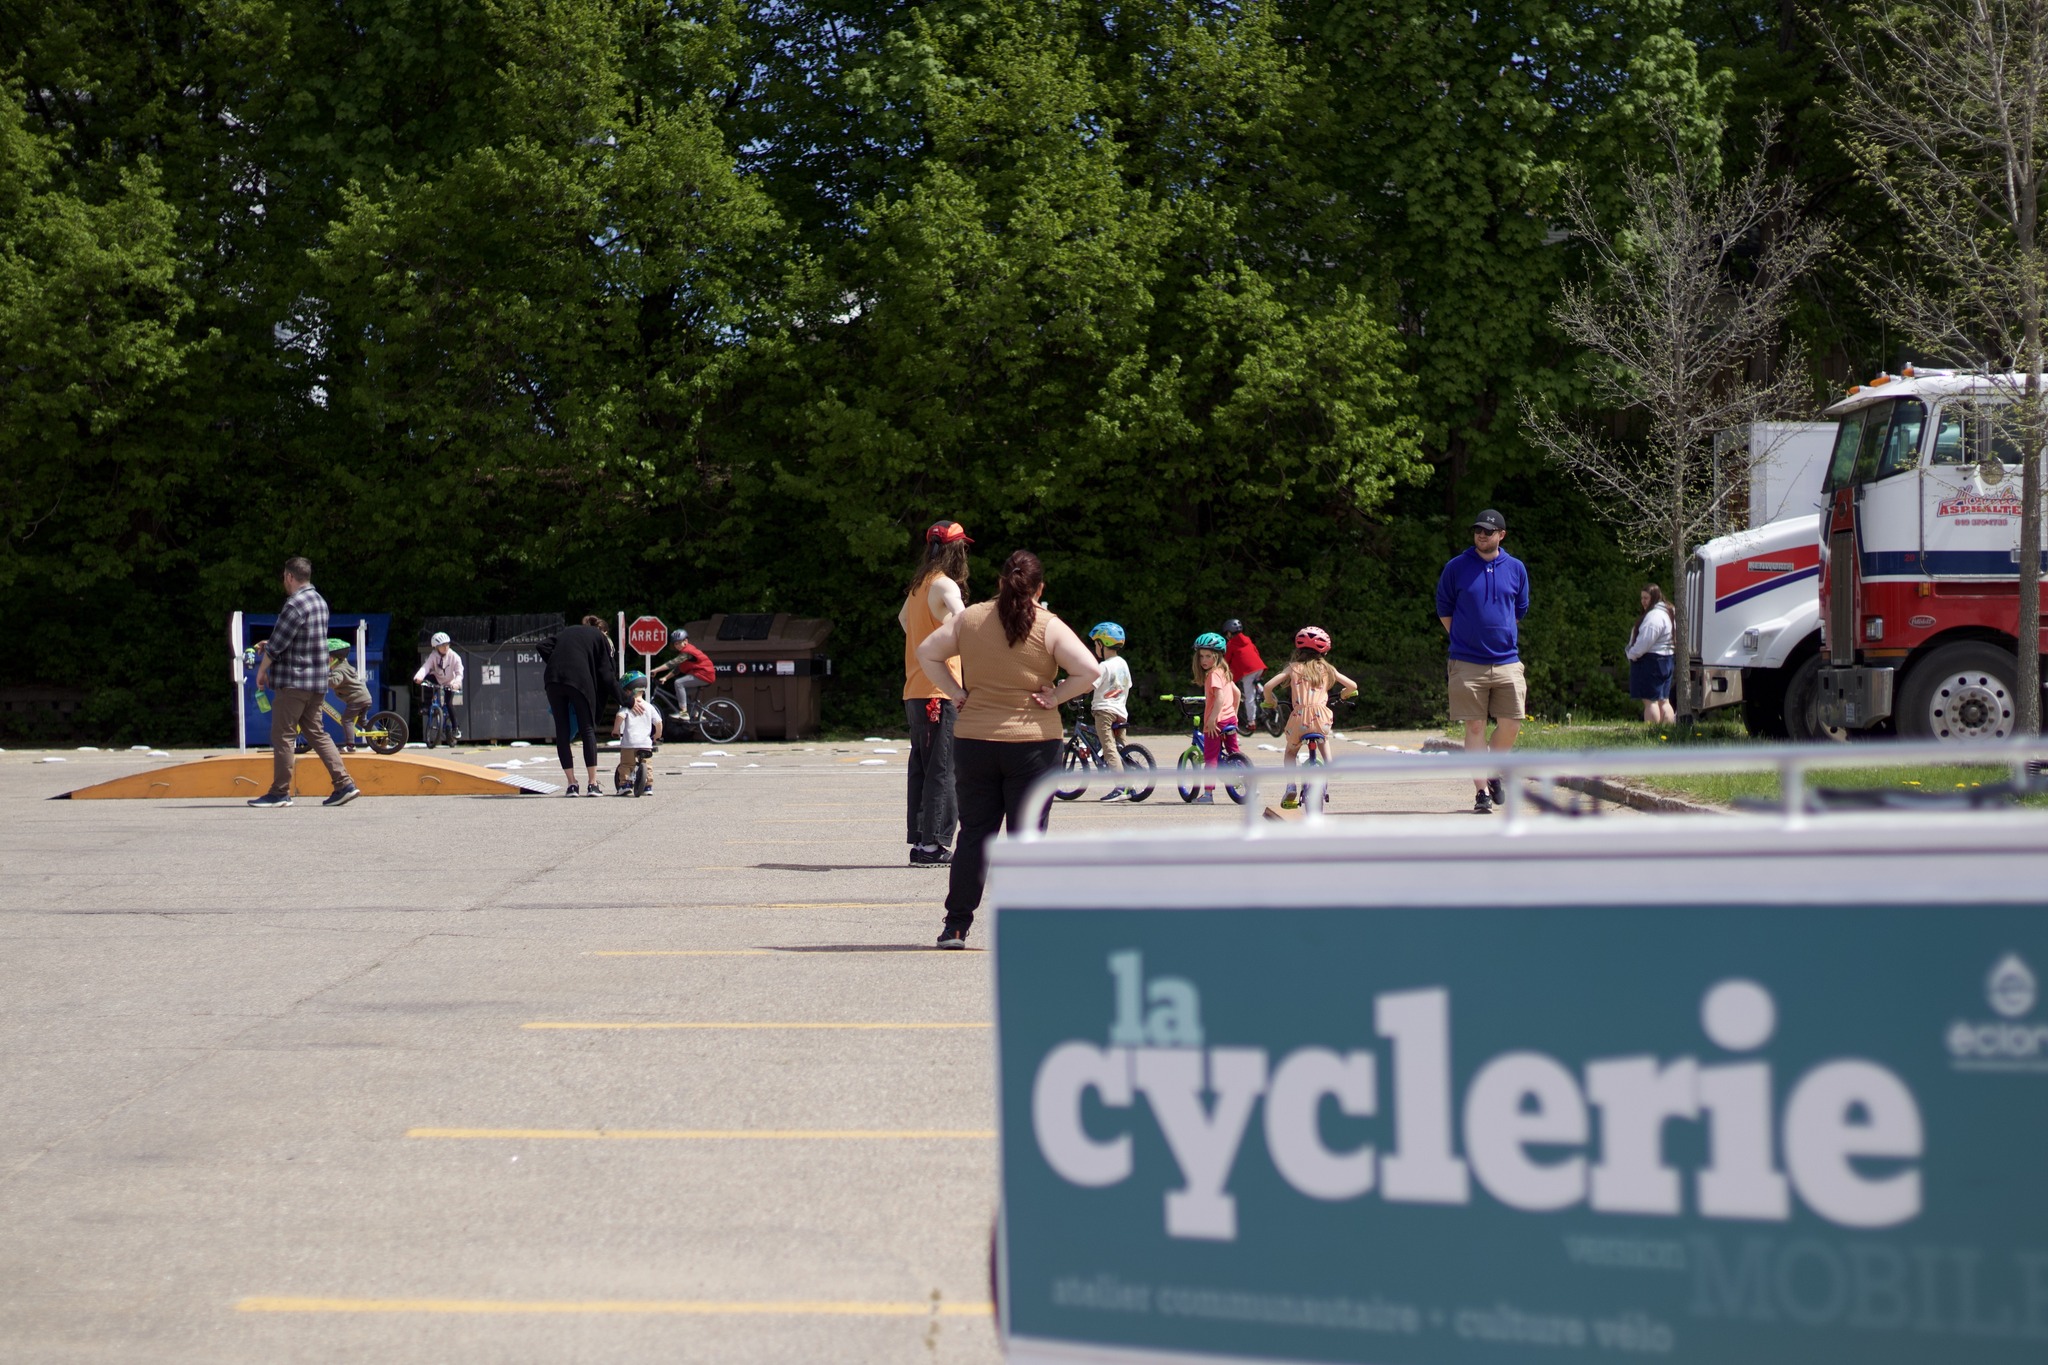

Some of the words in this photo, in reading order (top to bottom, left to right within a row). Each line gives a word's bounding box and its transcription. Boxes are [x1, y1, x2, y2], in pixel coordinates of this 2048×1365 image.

[631, 628, 665, 642] ARRÊT
[1108, 949, 1204, 1045] la
[1032, 977, 1924, 1241] cyclerie
[1052, 1272, 1150, 1313] atelier
[1156, 1282, 1420, 1335] communautaire
[1453, 1300, 1588, 1347] culture
[1591, 1306, 1674, 1355] vélo
